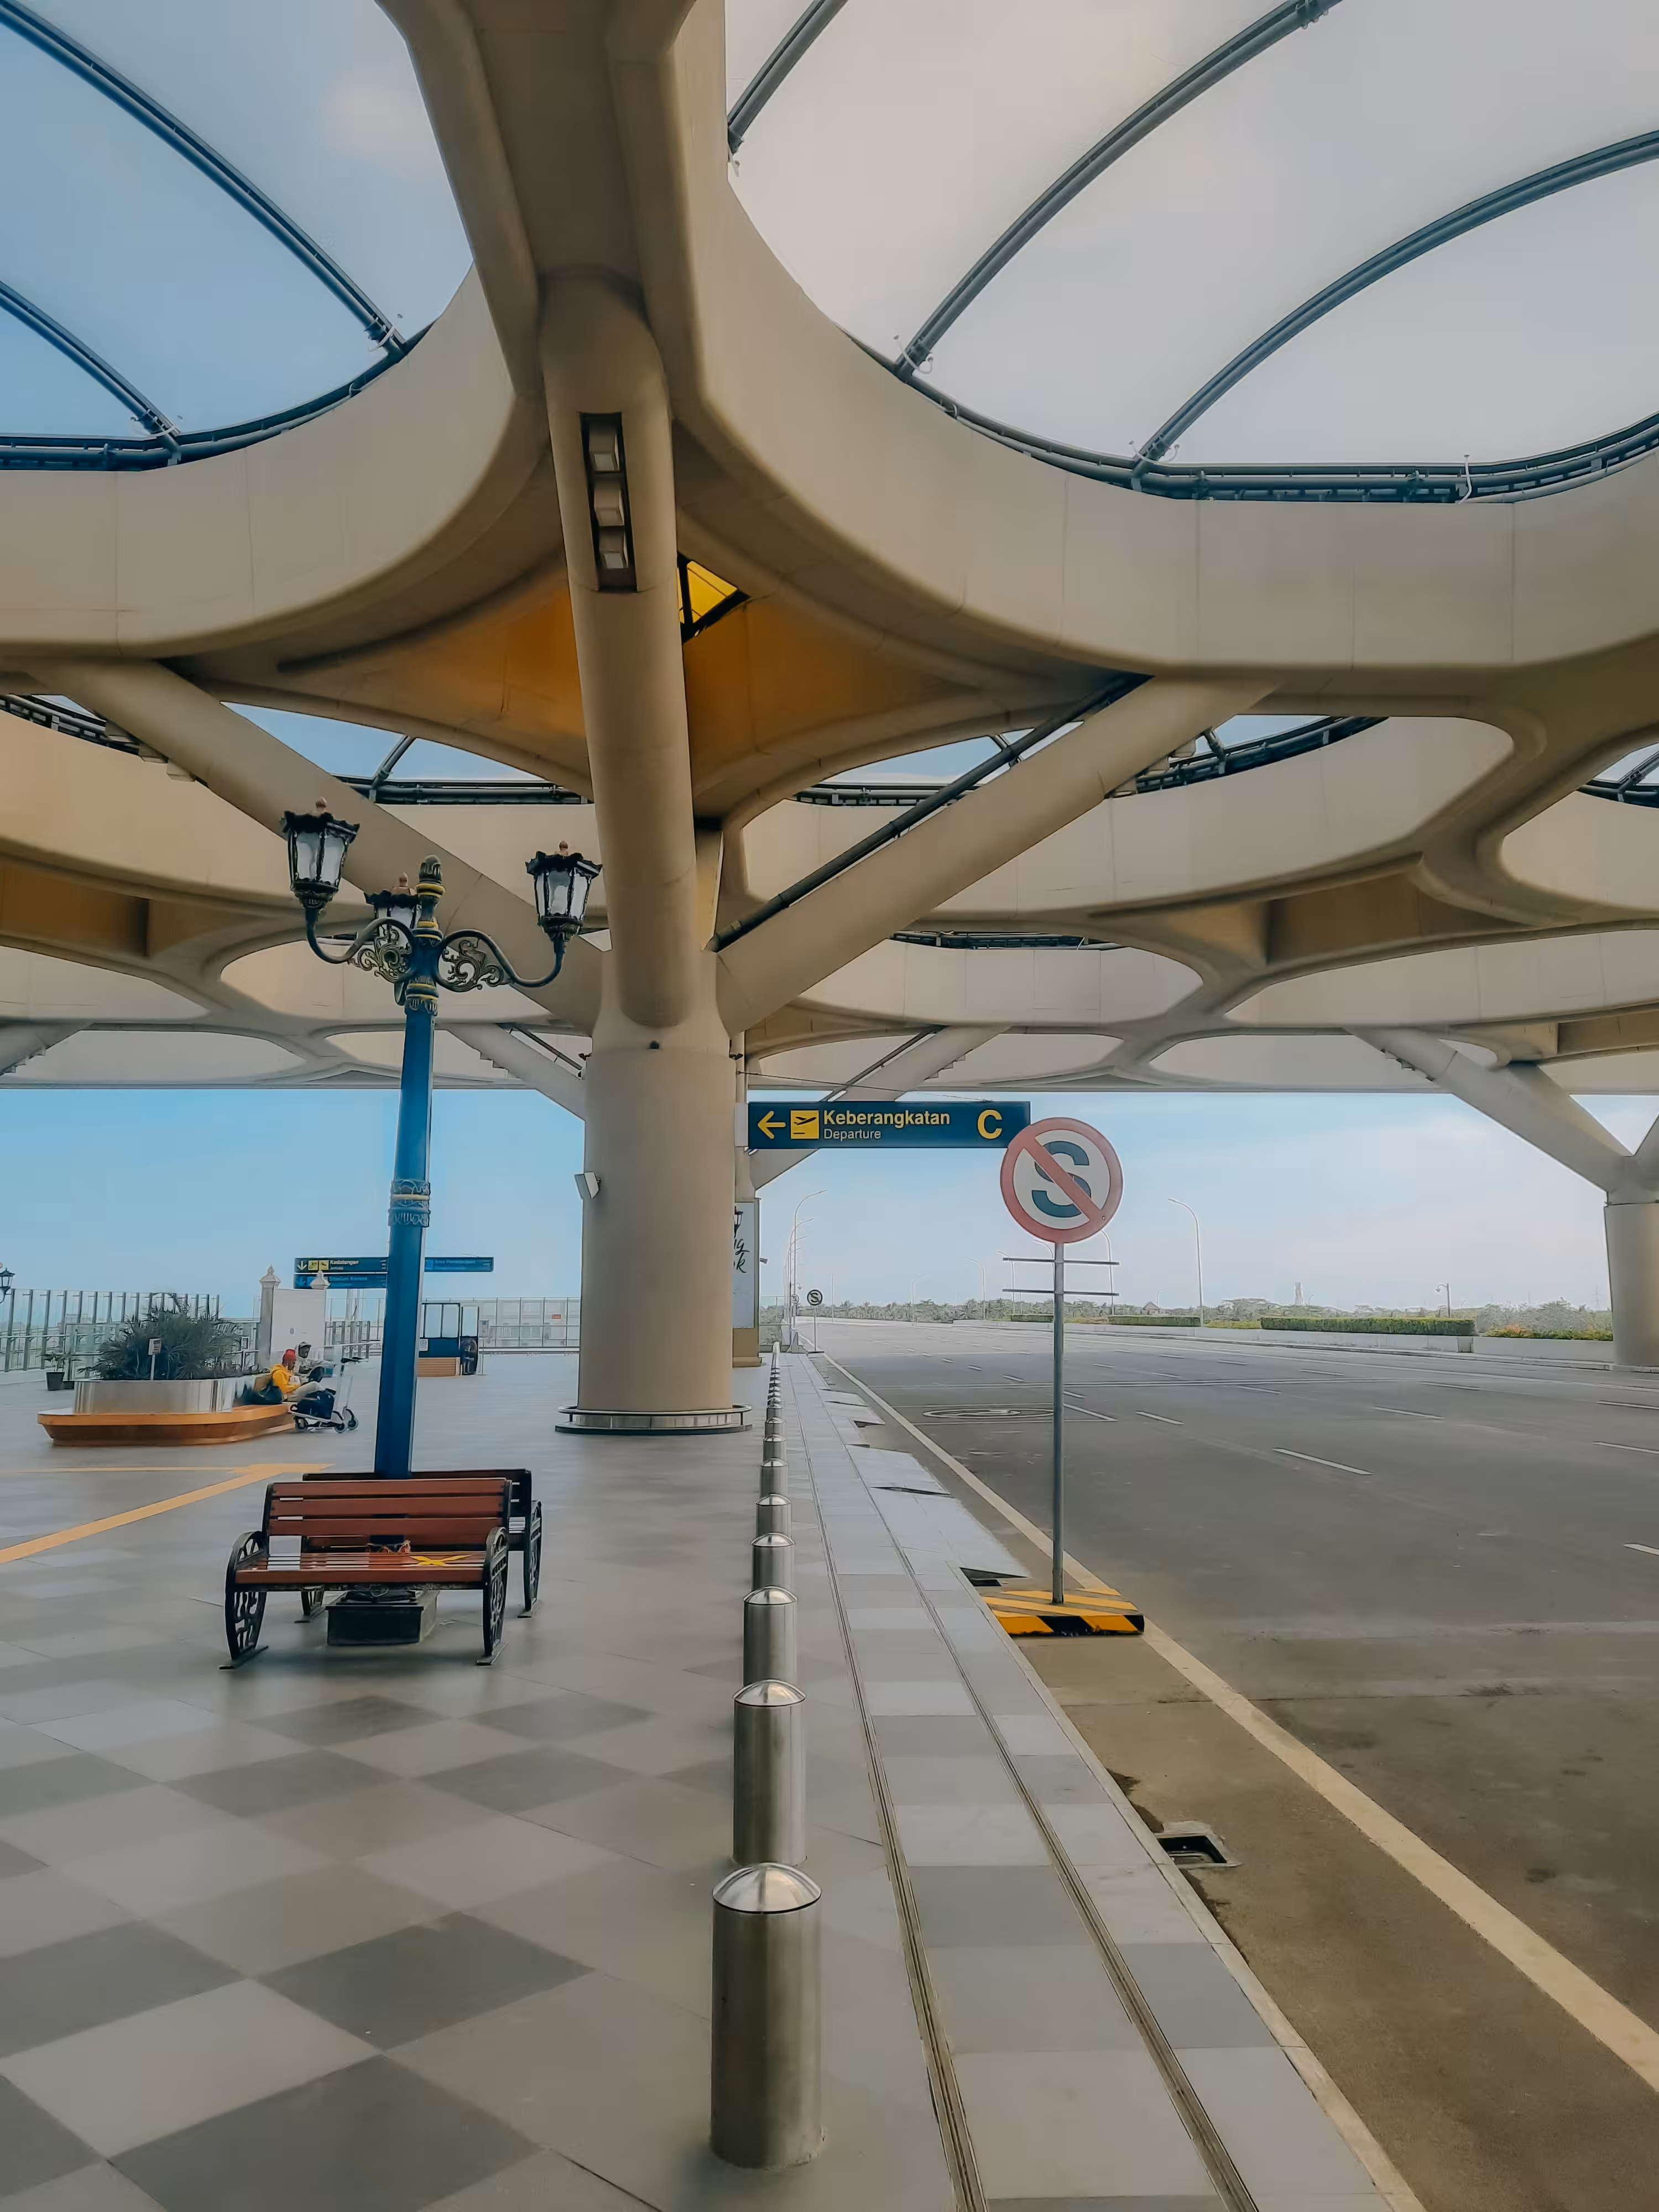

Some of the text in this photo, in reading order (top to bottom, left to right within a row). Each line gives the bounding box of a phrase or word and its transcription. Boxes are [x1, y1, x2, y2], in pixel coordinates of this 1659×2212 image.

[823, 1110, 950, 1129] Keberangkatan
[977, 1109, 1003, 1139] C
[824, 1129, 881, 1141] Departure
[1031, 1140, 1092, 1218] S
